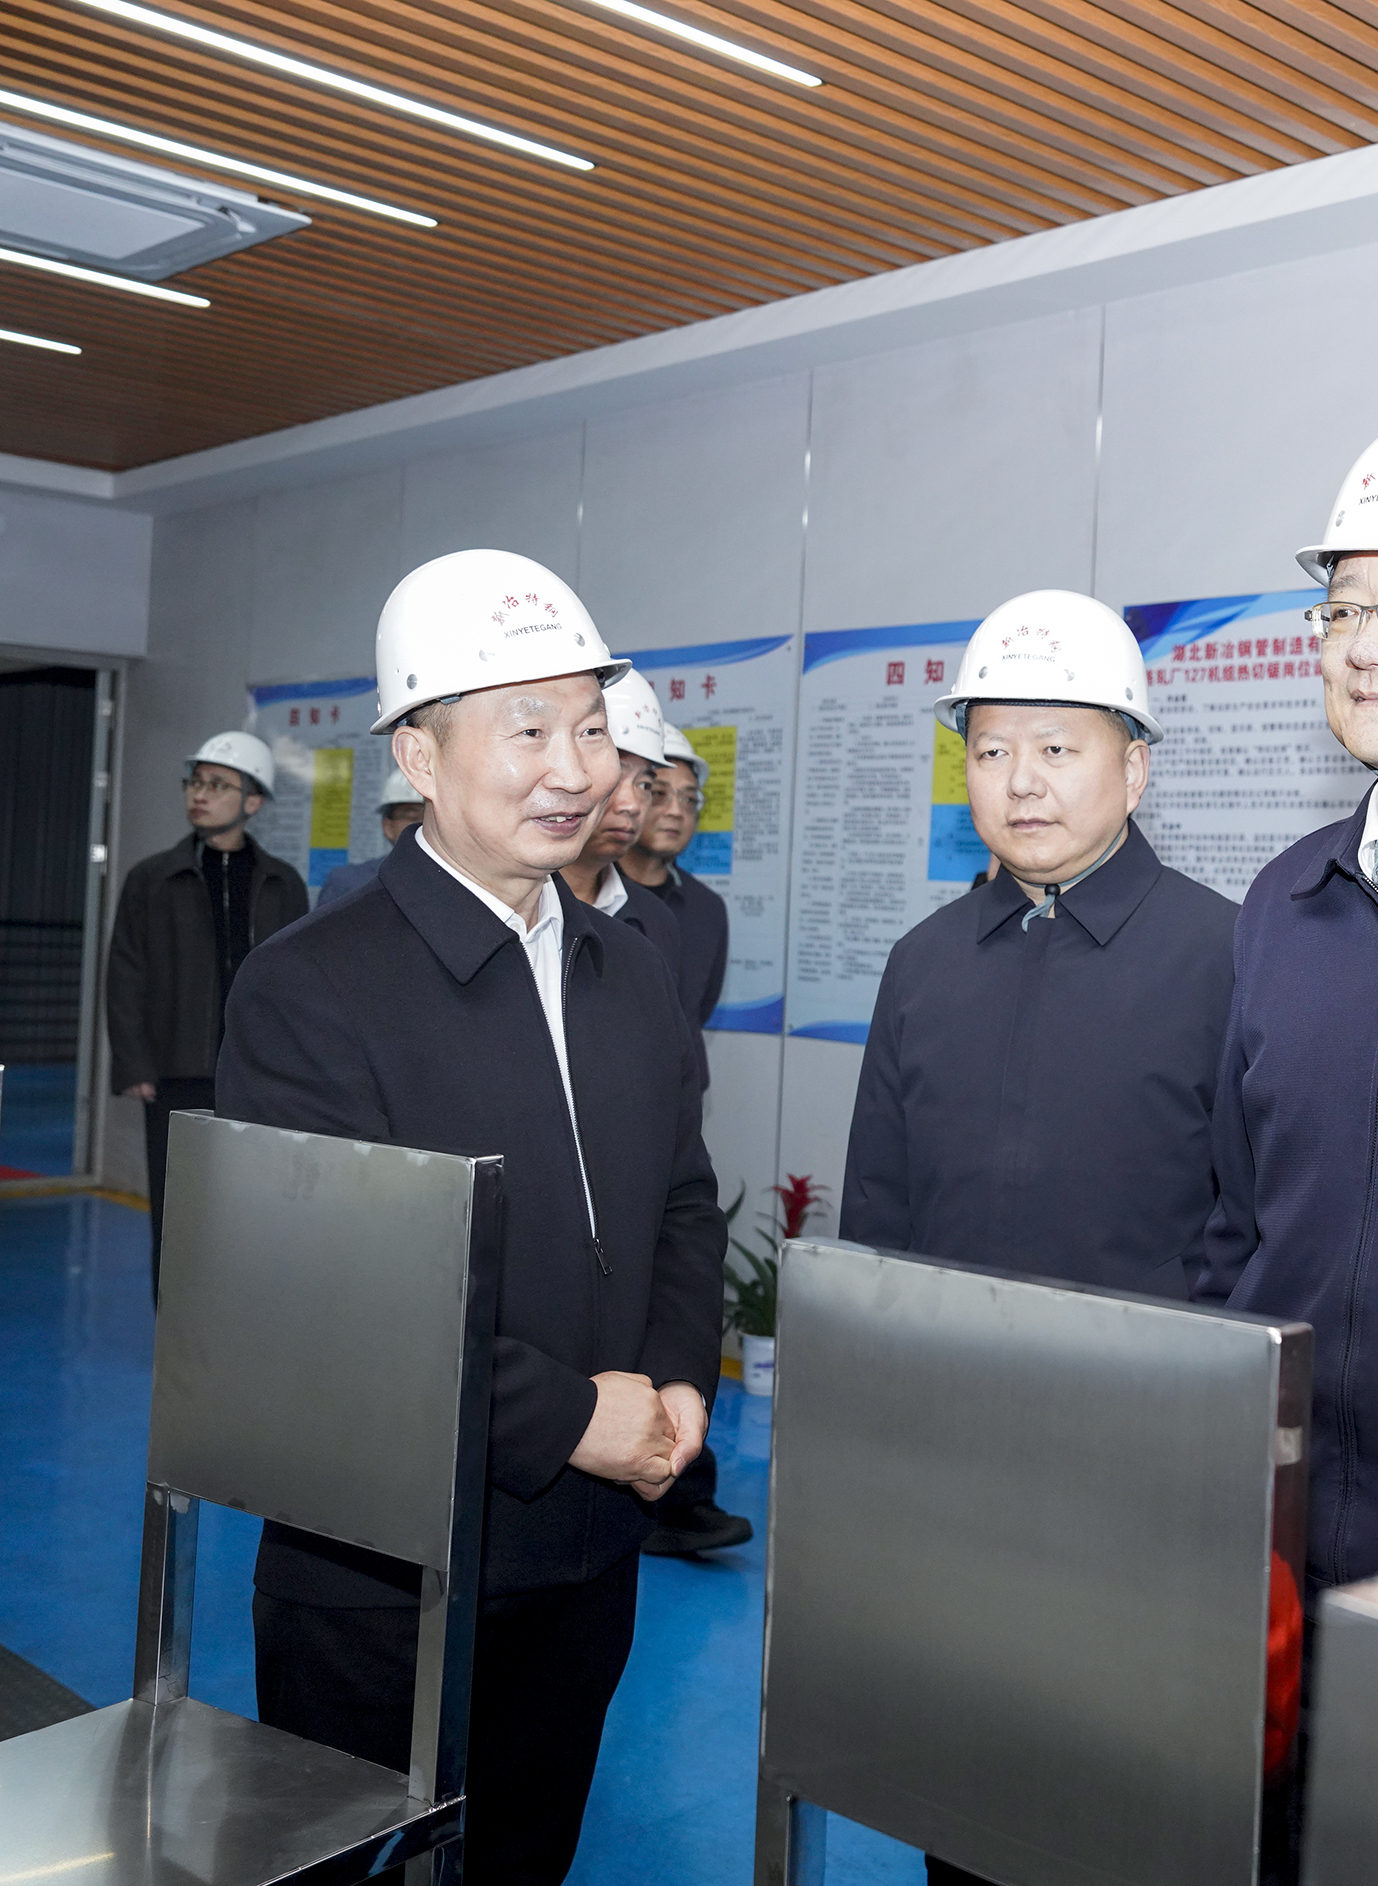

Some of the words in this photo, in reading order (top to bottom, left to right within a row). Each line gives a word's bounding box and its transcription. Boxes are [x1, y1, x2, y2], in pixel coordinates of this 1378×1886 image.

[503, 622, 563, 639] XINYETEGANG
[1001, 653, 1056, 663] XINYETEGANG
[886, 658, 945, 687] 四知
